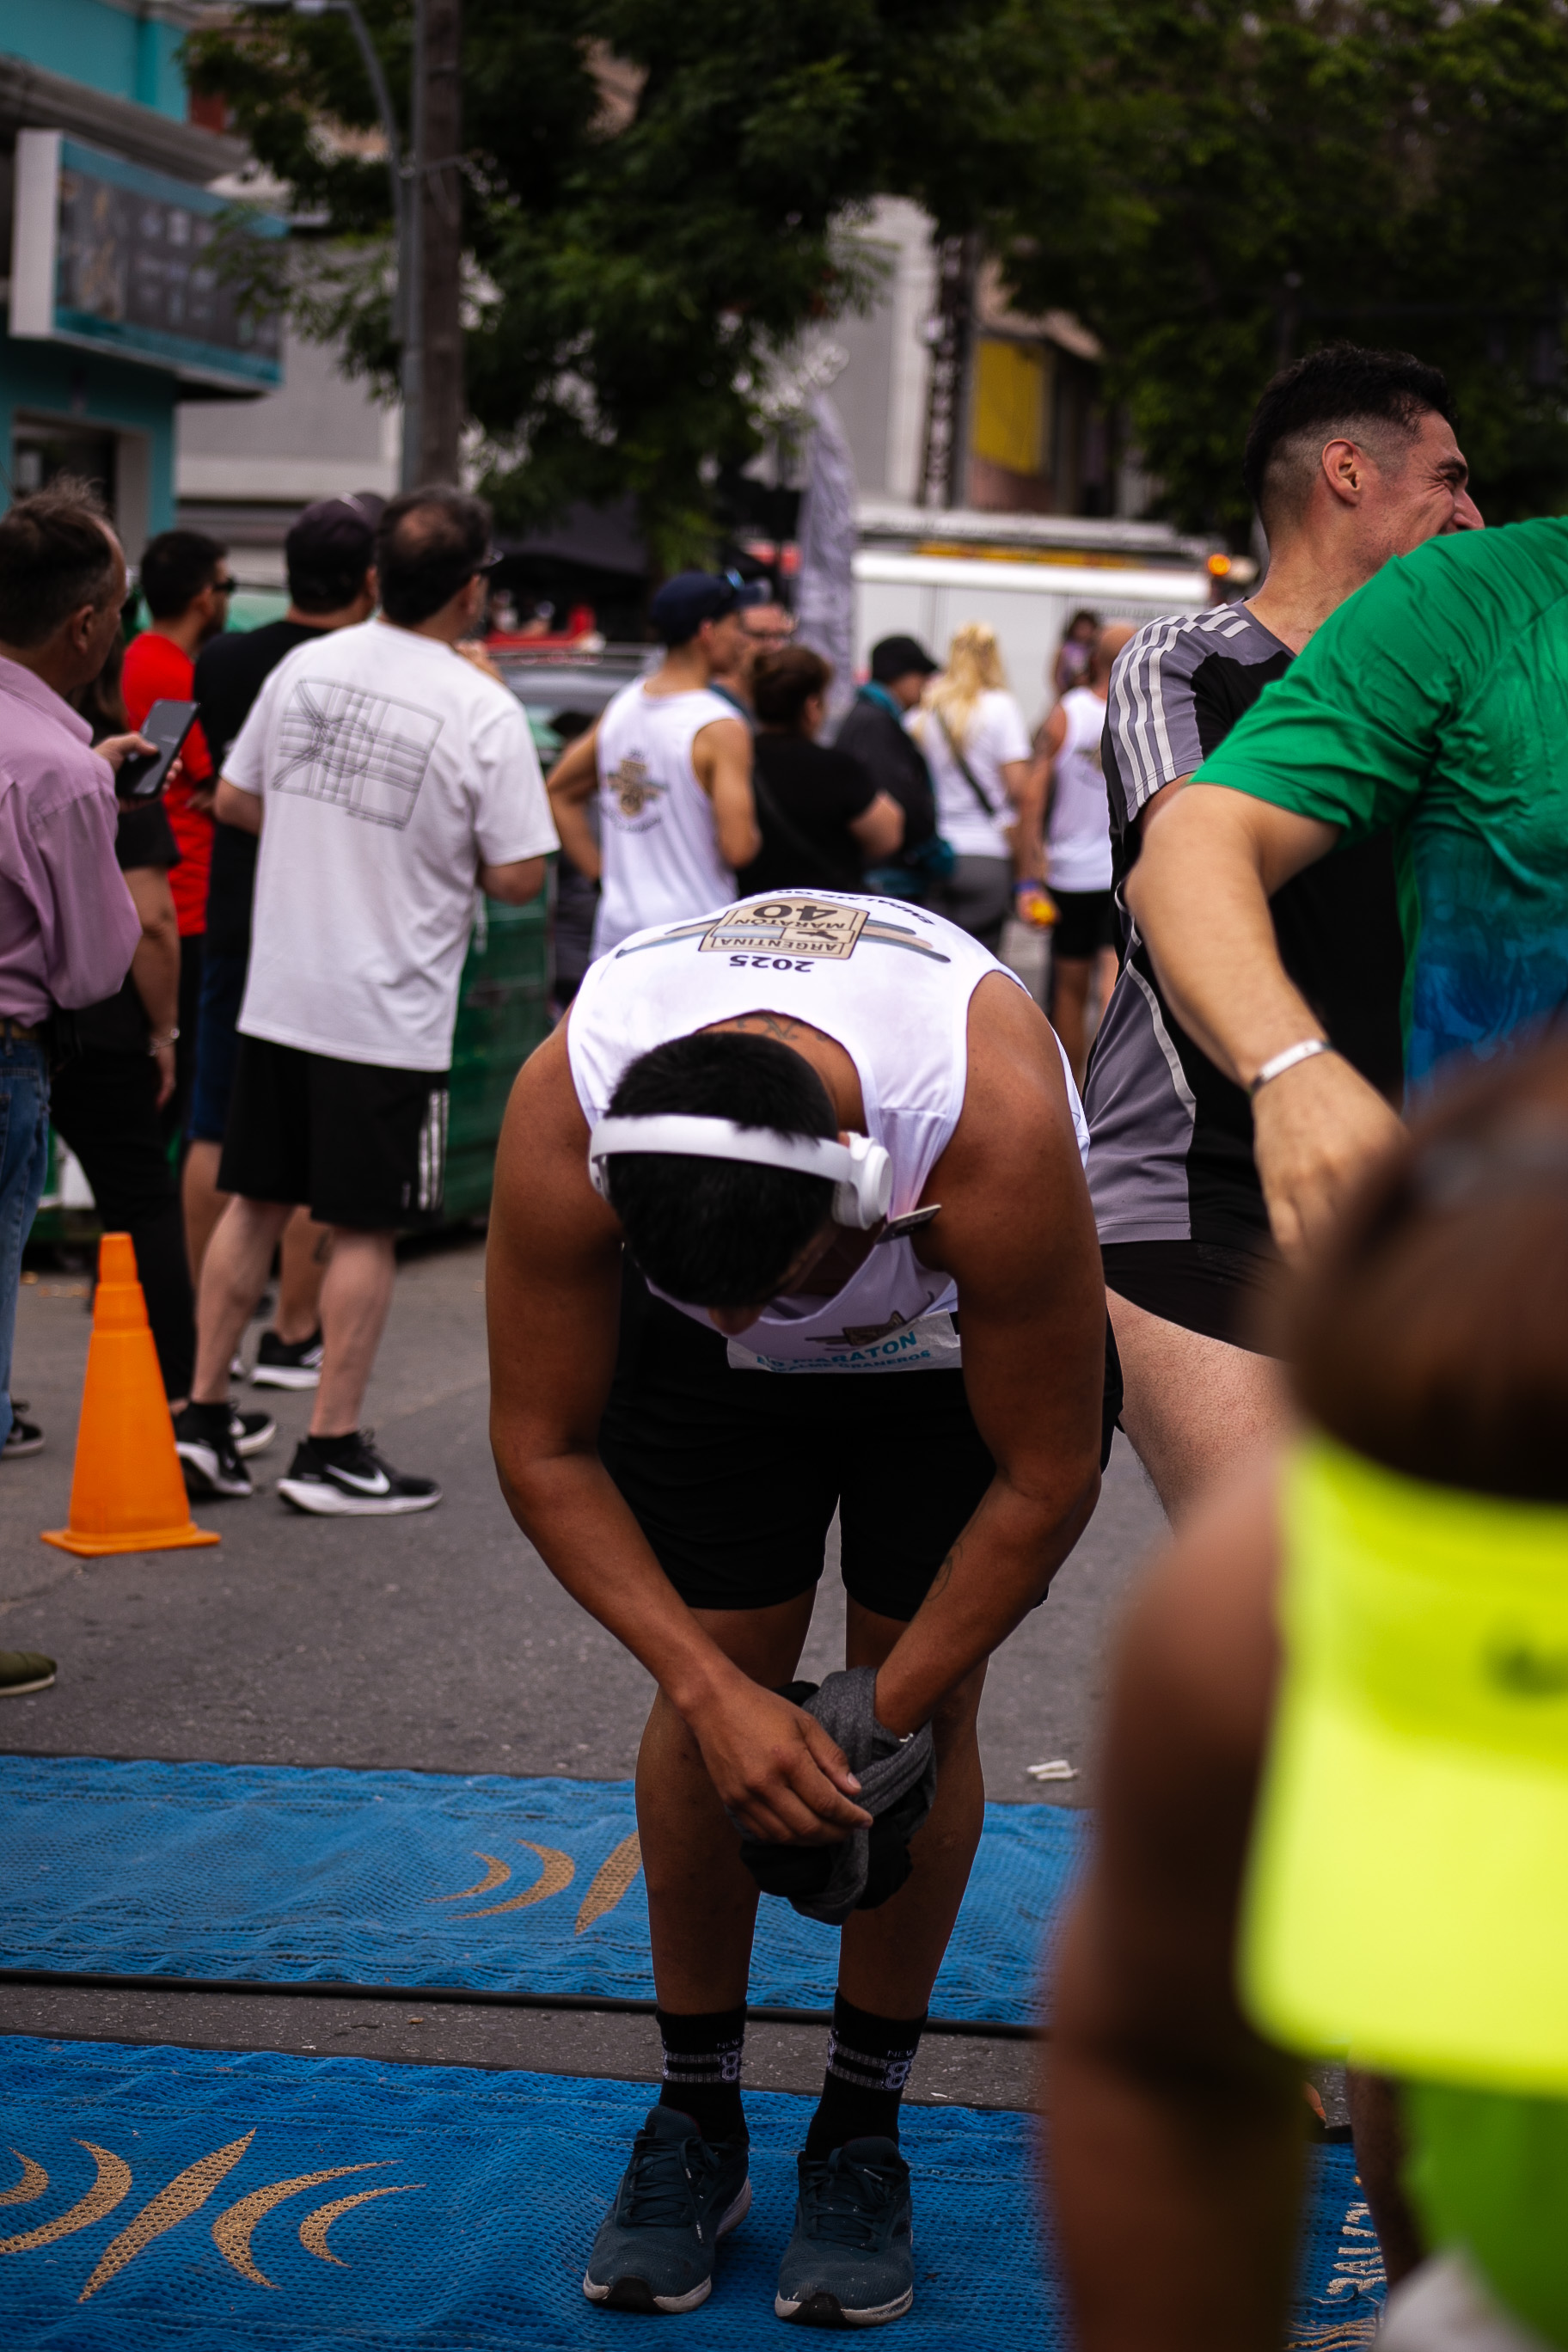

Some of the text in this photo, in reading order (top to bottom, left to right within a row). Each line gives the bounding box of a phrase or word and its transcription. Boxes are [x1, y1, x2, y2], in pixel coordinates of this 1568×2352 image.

[752, 904, 838, 922] 40
[734, 918, 846, 929] MARATÓN
[720, 937, 839, 952] ARGENTINA
[730, 954, 815, 972] 2025
[887, 2049, 914, 2058] NEW
